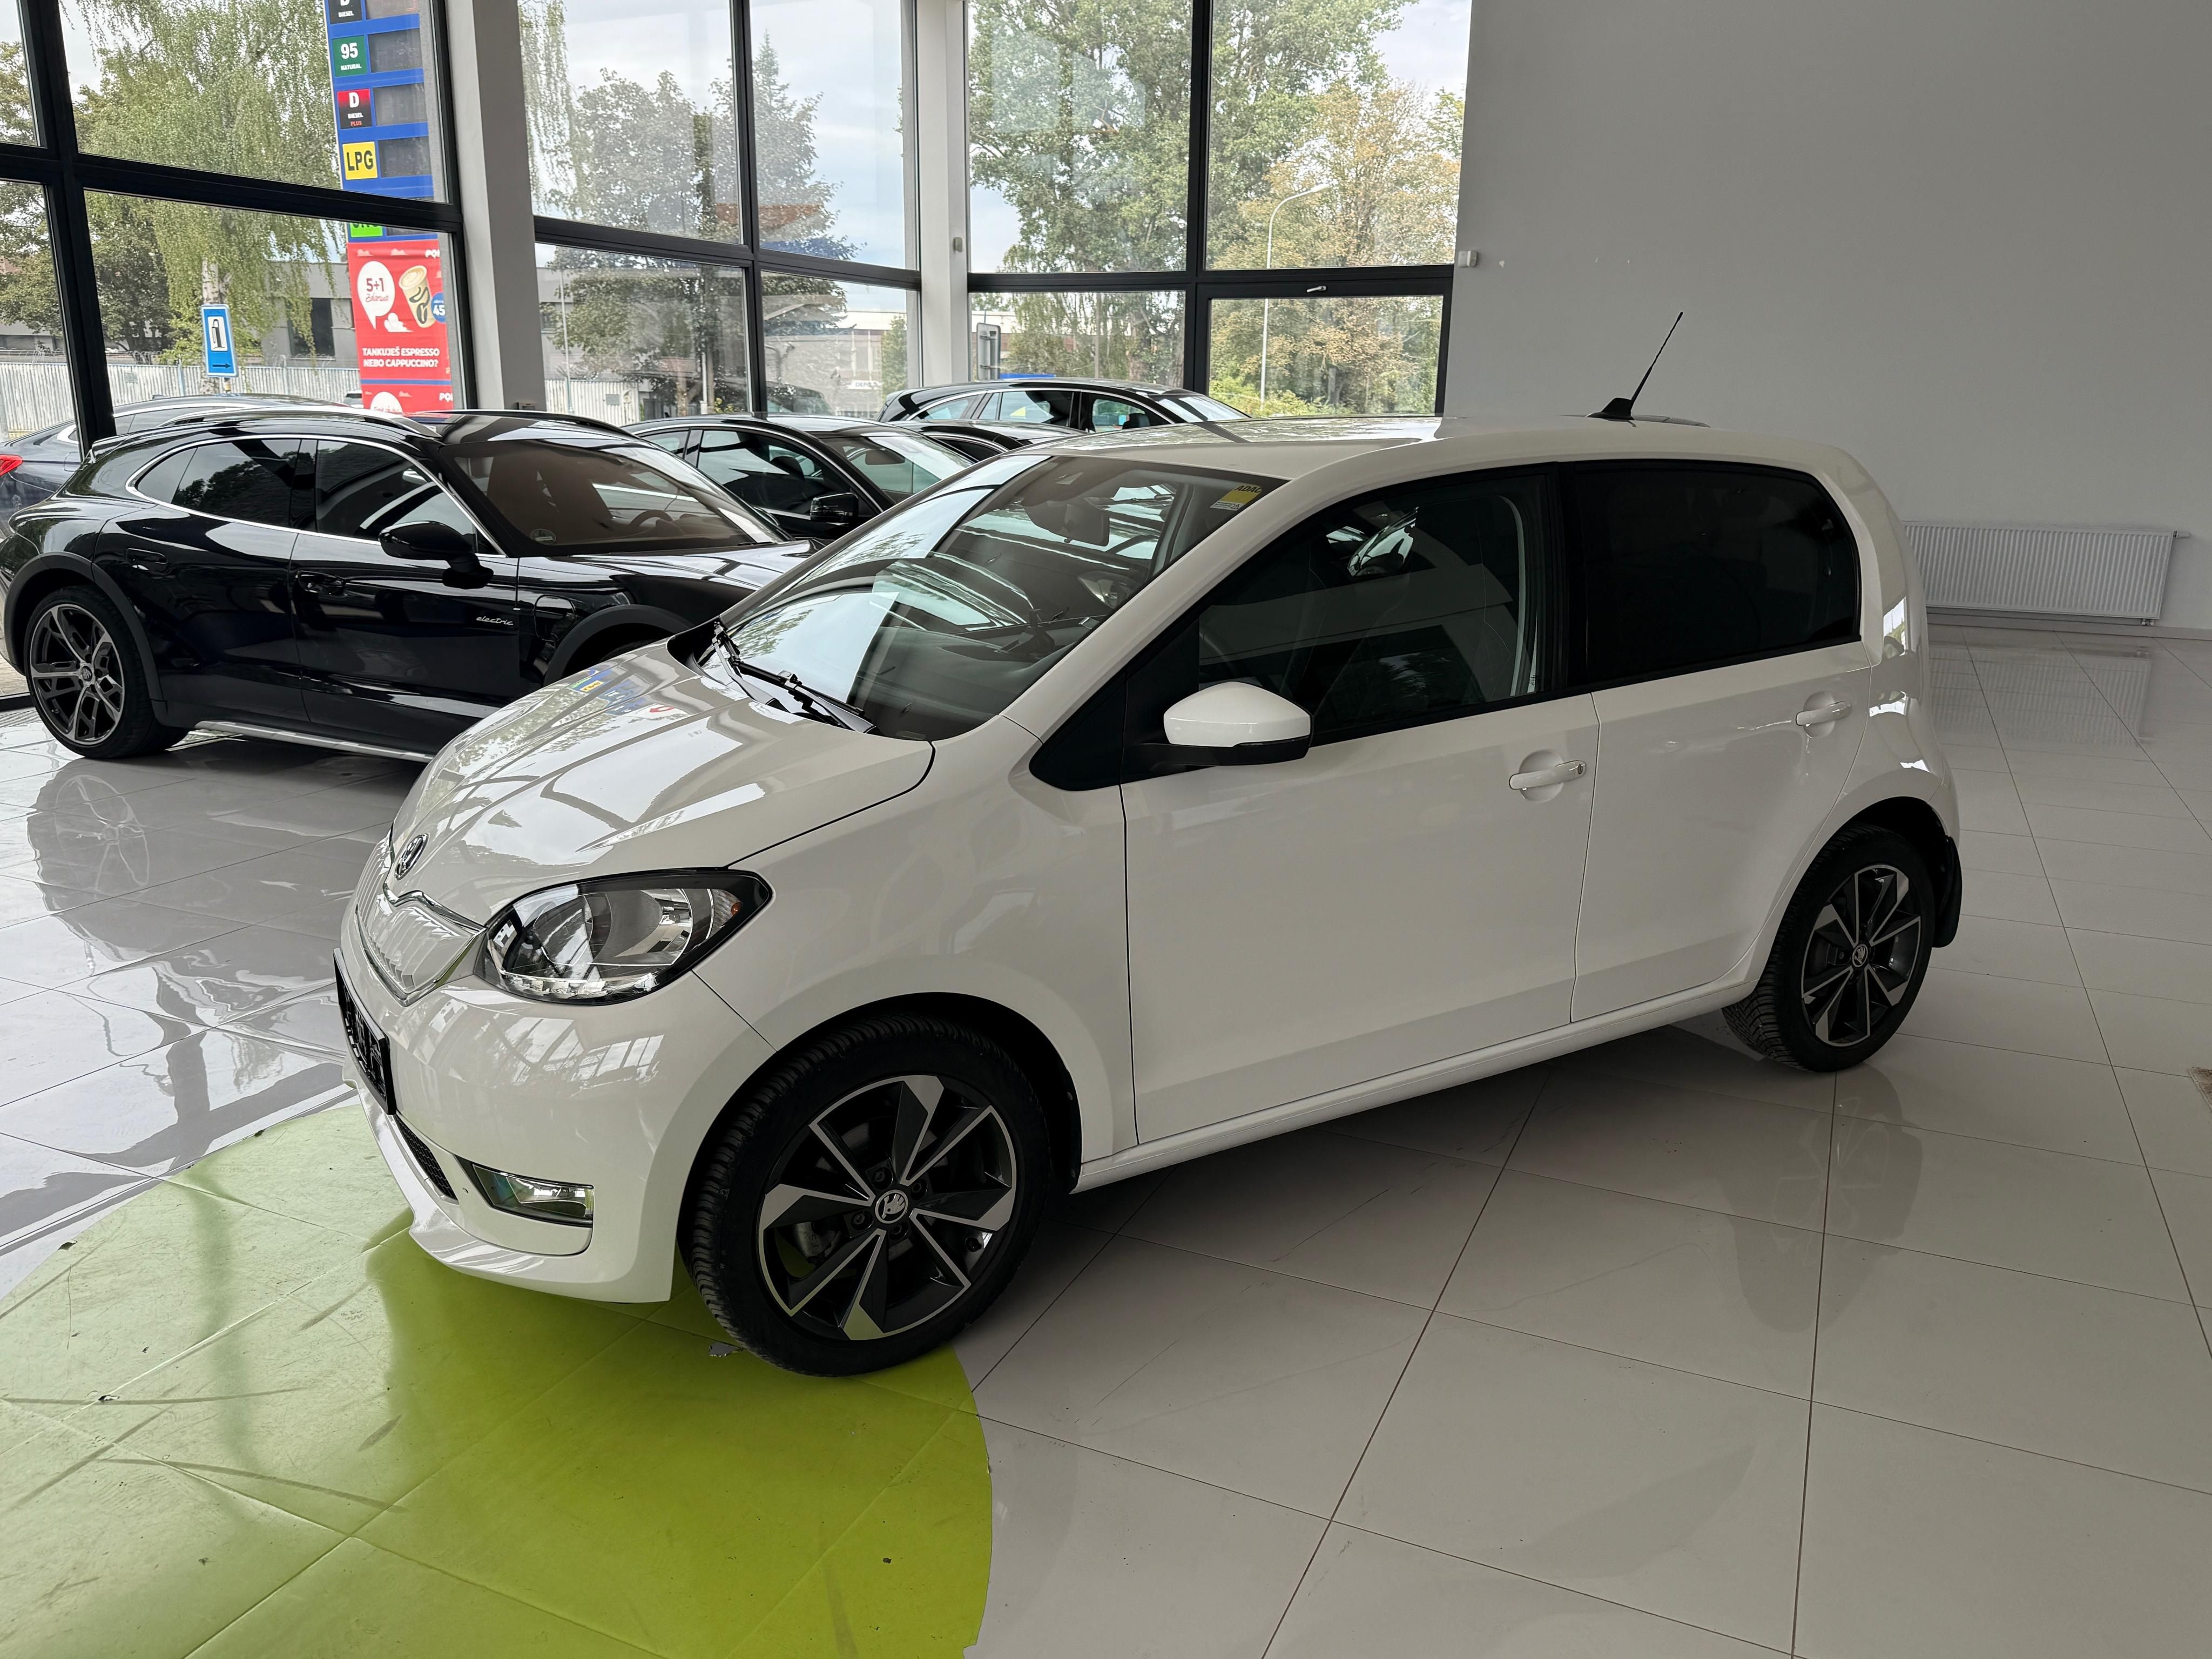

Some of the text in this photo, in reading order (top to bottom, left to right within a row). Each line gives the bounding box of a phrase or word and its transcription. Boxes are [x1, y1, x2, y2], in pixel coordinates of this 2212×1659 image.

[341, 43, 358, 59] 95
[349, 92, 360, 108] D
[346, 150, 374, 171] LPG
[366, 278, 384, 292] 5+1
[433, 305, 446, 315] 45
[362, 346, 440, 356] TANKUJEŠ ESPRESSO
[363, 359, 439, 368] NEBO CAPPUCCINO?
[1234, 485, 1262, 493] ADAC
[476, 616, 514, 625] electric
